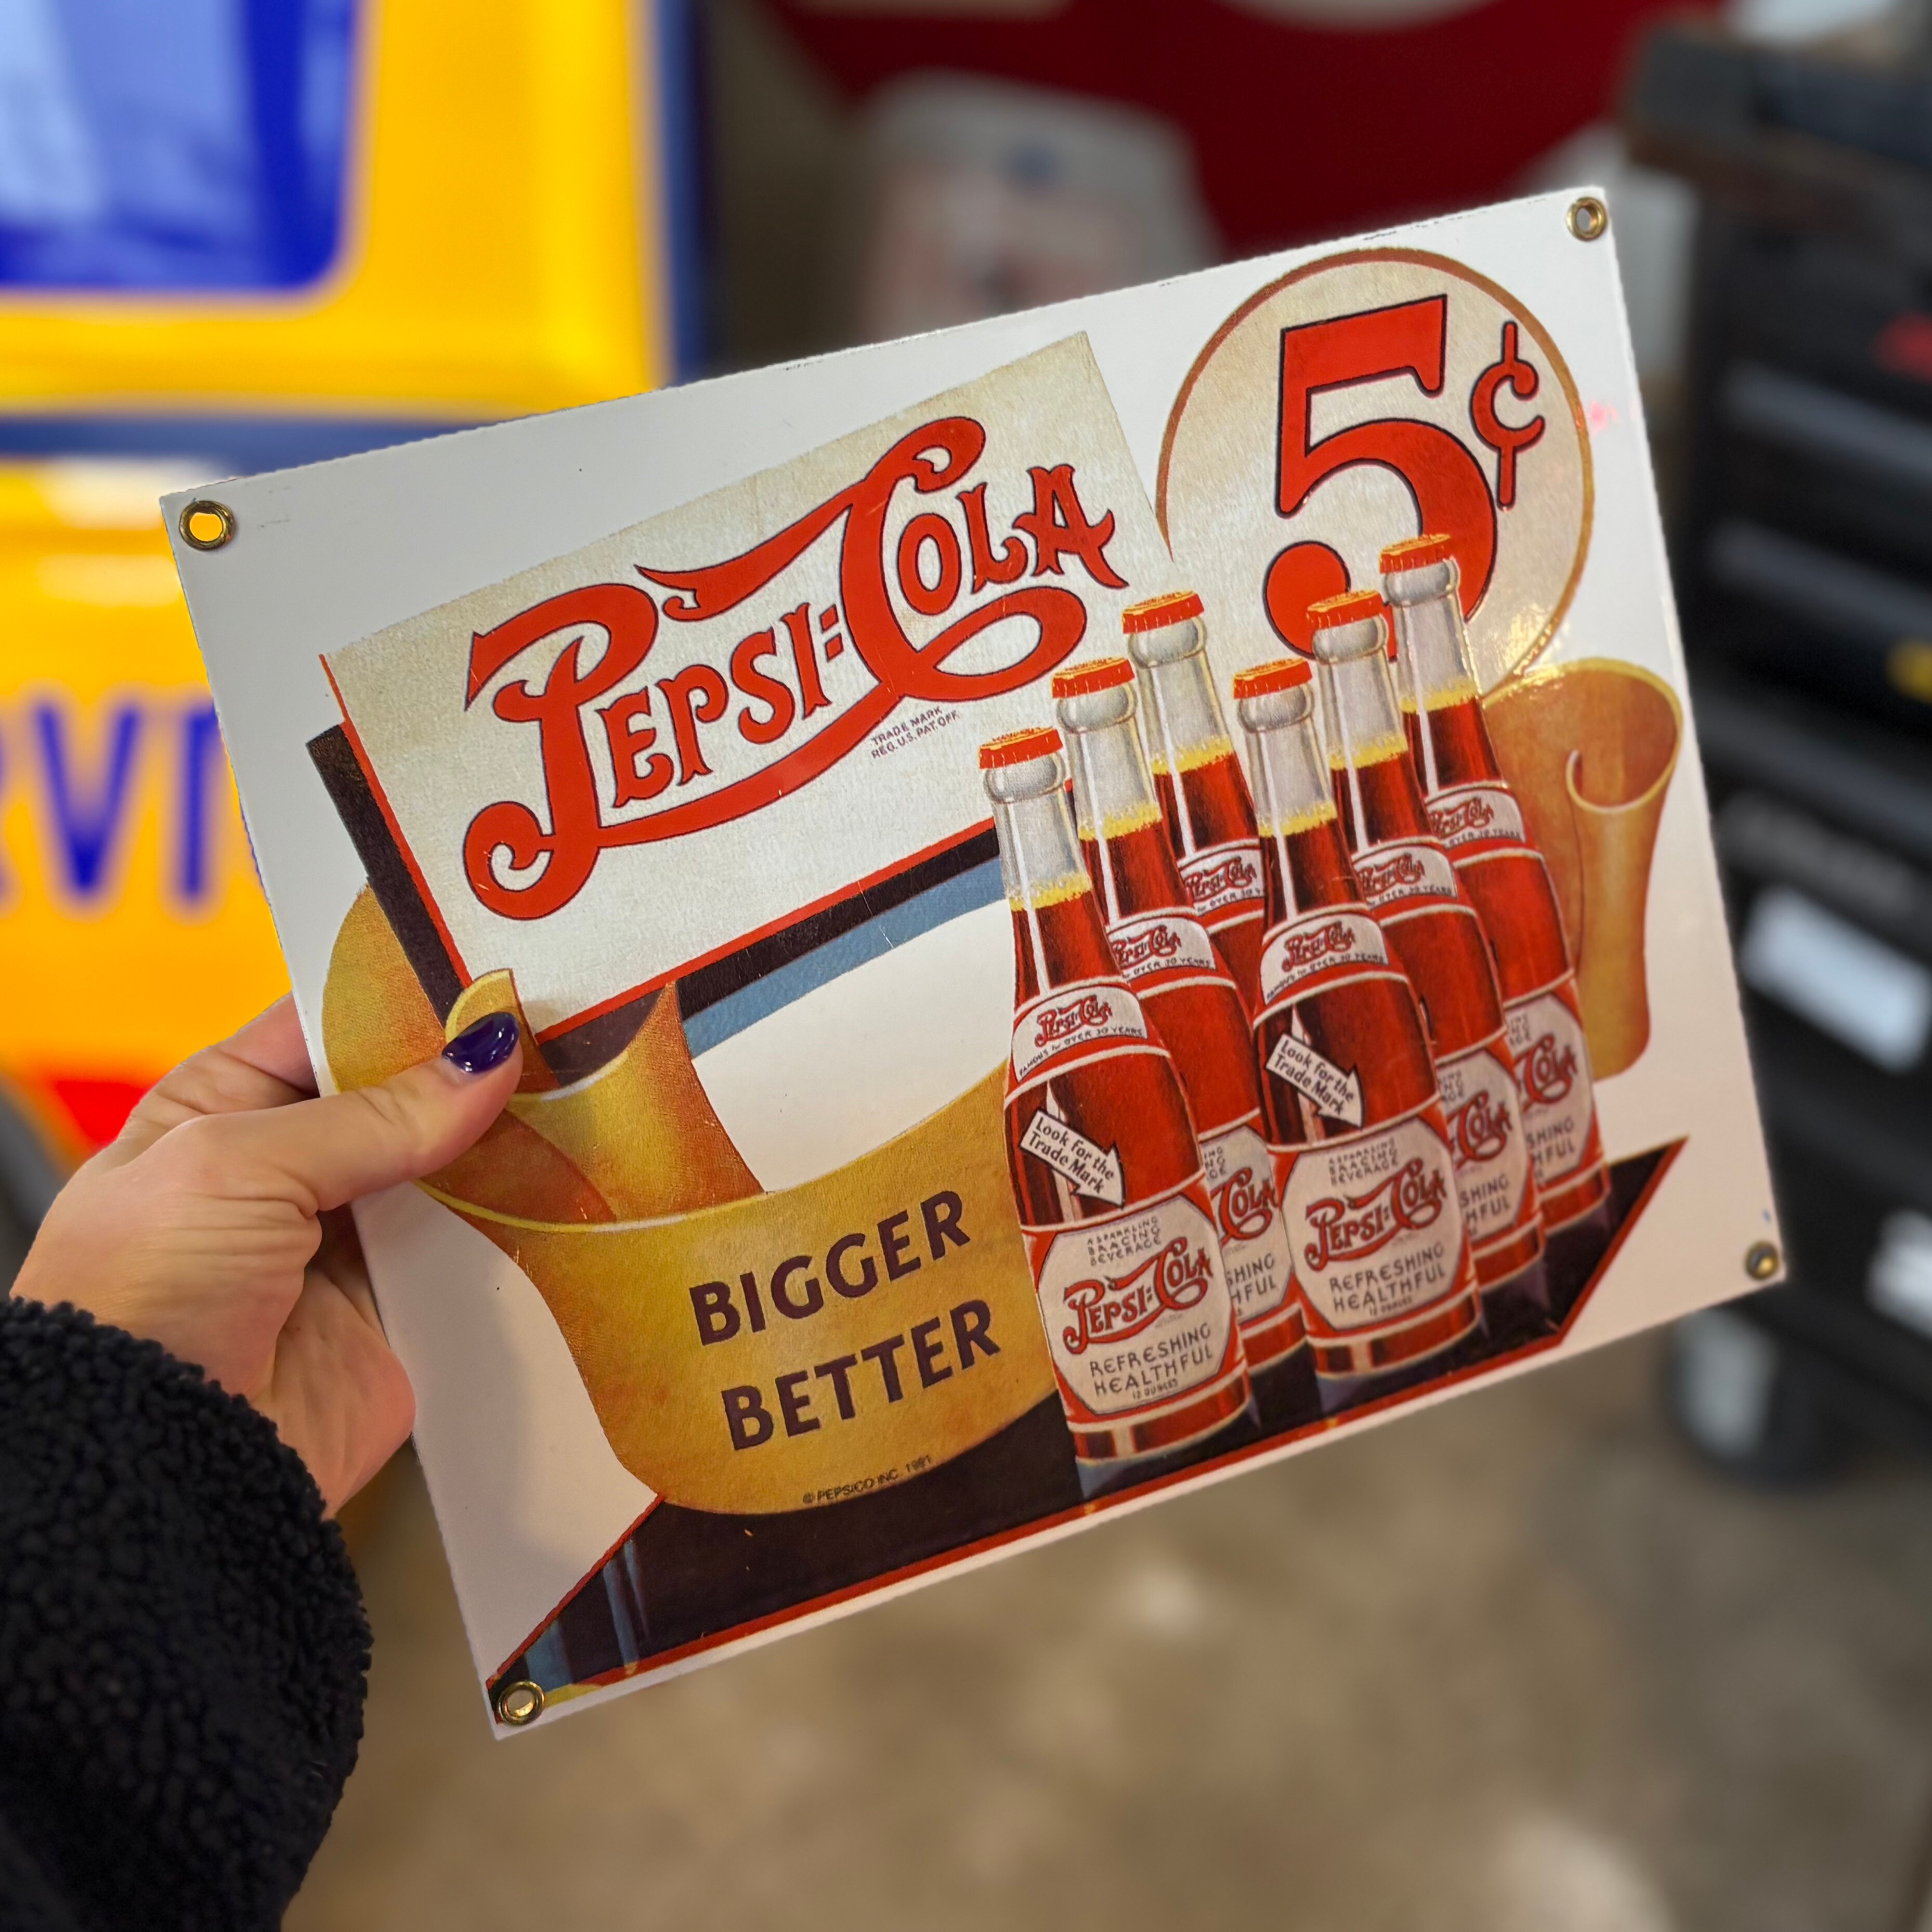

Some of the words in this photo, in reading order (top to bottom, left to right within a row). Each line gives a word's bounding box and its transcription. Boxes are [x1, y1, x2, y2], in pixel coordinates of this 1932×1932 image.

[871, 722, 909, 746] TRADE
[910, 706, 943, 727] MARK
[1020, 1050, 1049, 1076] FAMOUS
[1064, 1030, 1091, 1045] OVER
[1281, 1039, 1312, 1069] Look
[1314, 1061, 1334, 1082] for
[1334, 1078, 1354, 1103] the
[1274, 1053, 1312, 1089] Trade
[1311, 1080, 1344, 1116] Mark
[1029, 1131, 1069, 1166] Trade
[1068, 1158, 1104, 1194] Mark
[1036, 1116, 1069, 1147] Look
[1071, 1139, 1092, 1161] for
[1092, 1156, 1114, 1180] the
[1088, 1225, 1160, 1256] BRACING
[1090, 1236, 1161, 1267] BEVERAGE
[1096, 1216, 1158, 1243] SPARKLING
[689, 1190, 971, 1346] BIGGER
[1329, 1242, 1444, 1293] REFRESHING
[1333, 1263, 1445, 1312] HEALTHFUL
[722, 1299, 1001, 1451] BETTER
[1090, 1322, 1211, 1377] REFRESHING
[1094, 1342, 1213, 1397] HEALTHFUL
[817, 1478, 874, 1502] PEPSICO
